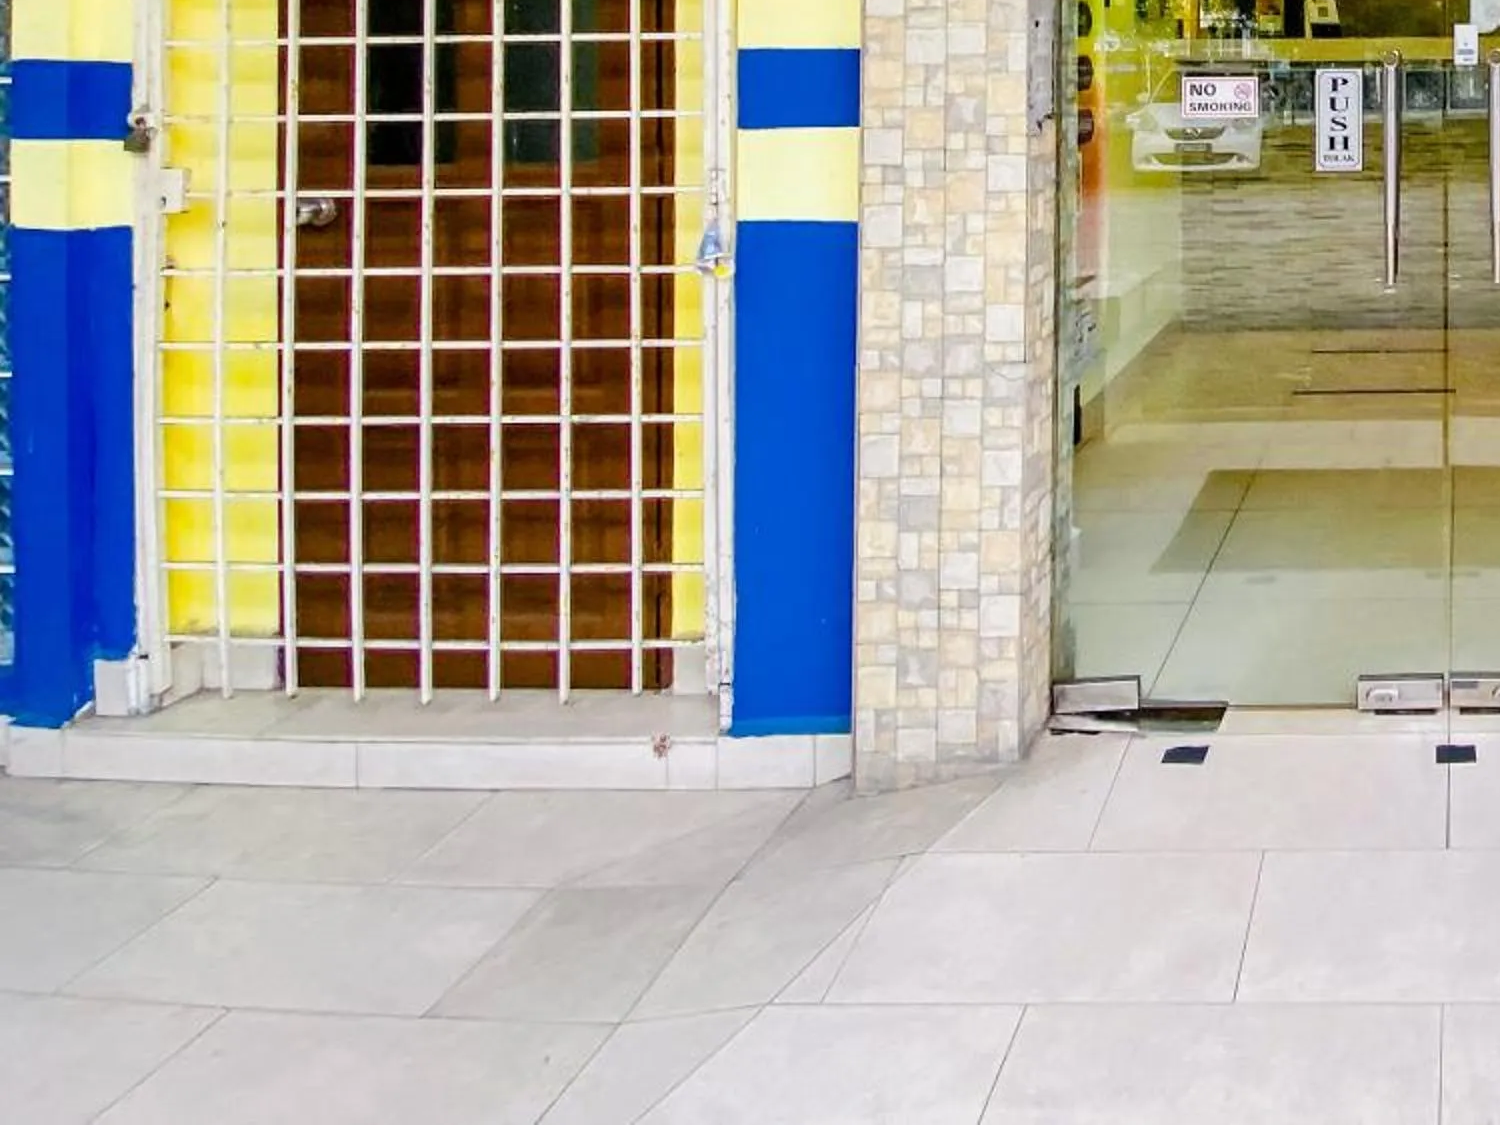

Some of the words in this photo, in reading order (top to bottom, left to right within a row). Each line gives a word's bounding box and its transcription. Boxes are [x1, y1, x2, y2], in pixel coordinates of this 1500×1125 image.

[1189, 83, 1217, 97] NO
[1189, 102, 1252, 112] SMOKING
[1328, 77, 1349, 150] PUSH
